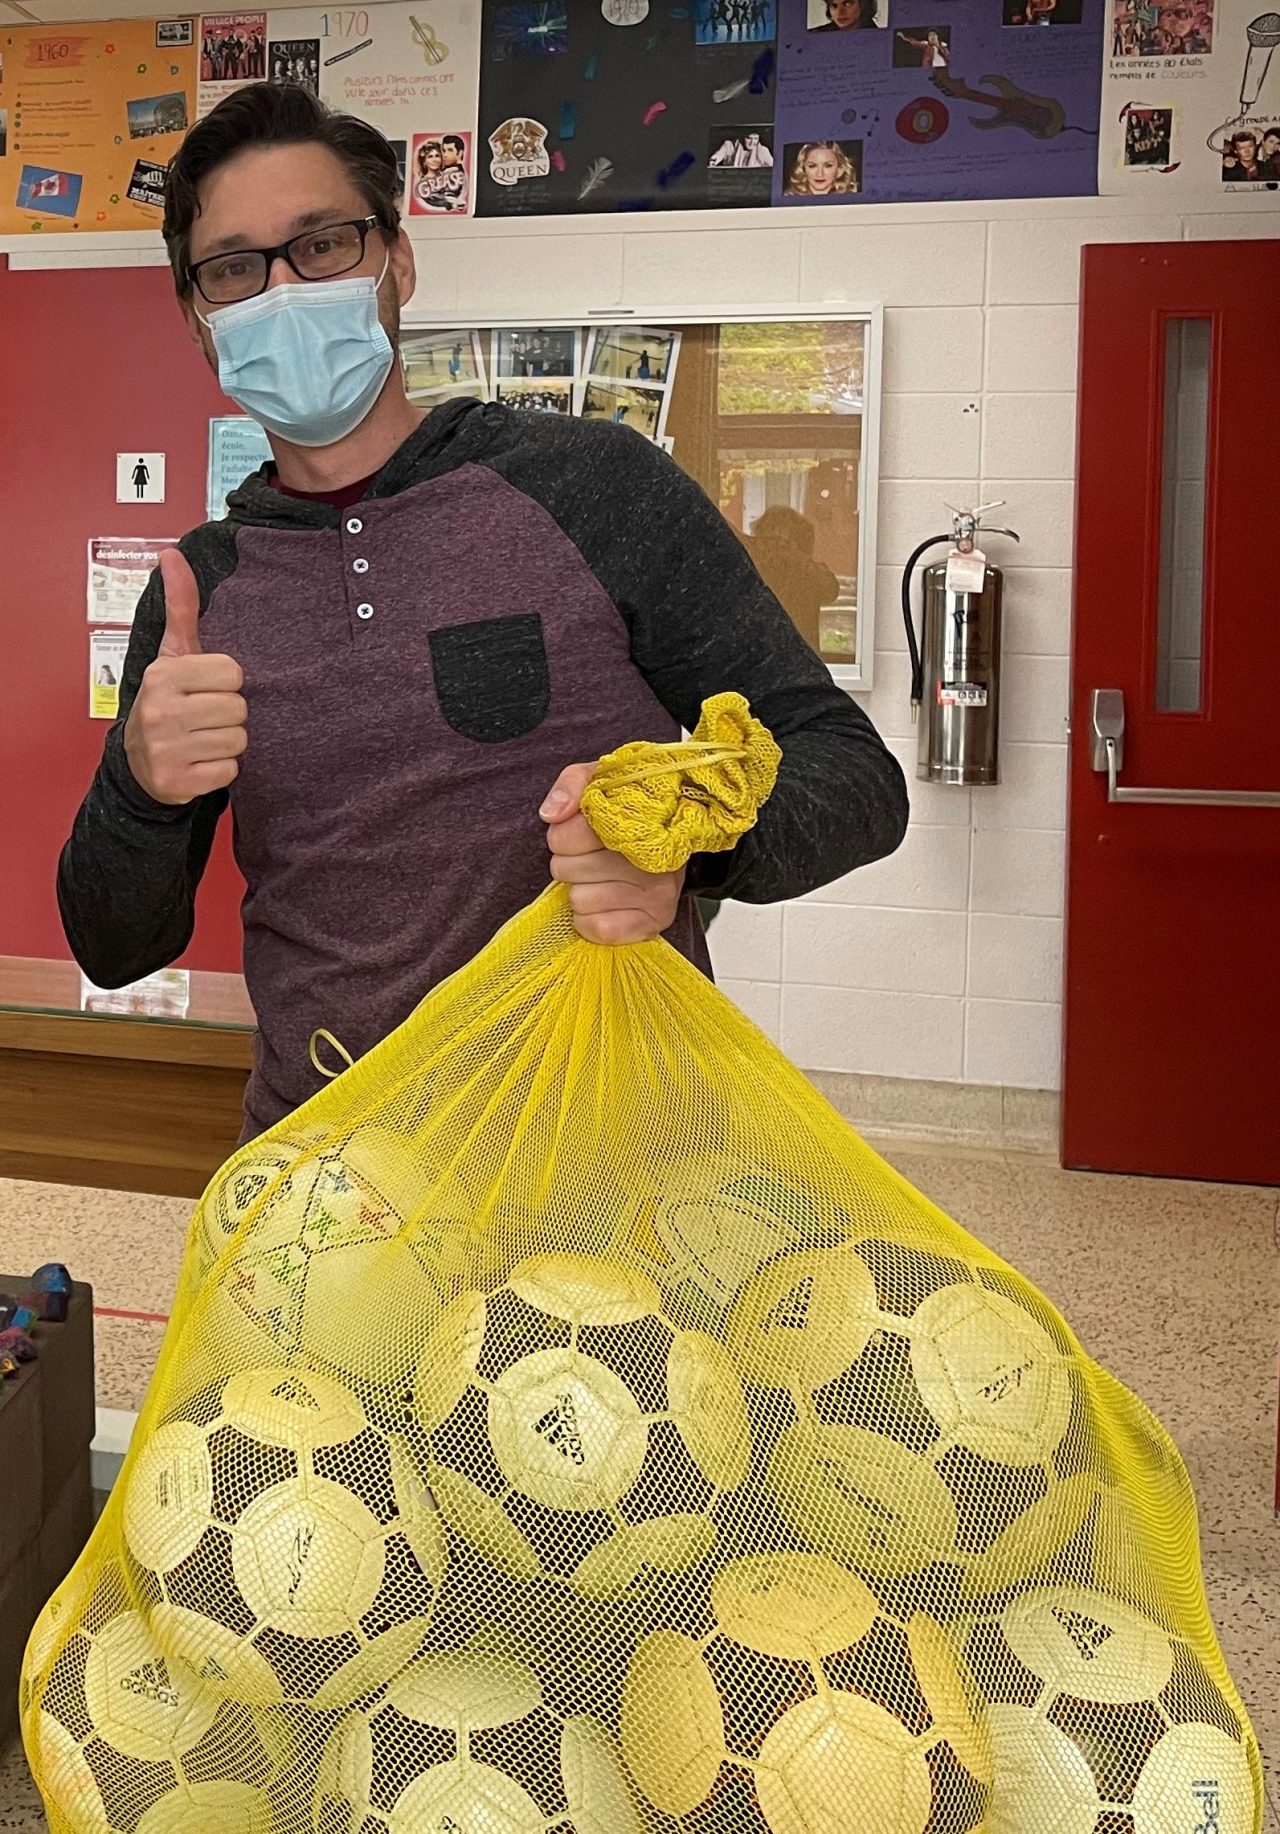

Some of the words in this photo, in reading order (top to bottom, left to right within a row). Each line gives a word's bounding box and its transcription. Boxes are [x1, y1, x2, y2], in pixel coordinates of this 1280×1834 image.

[204, 17, 234, 26] VILLAGE
[236, 15, 264, 25] PEOPLE
[320, 10, 369, 37] 1970
[36, 44, 70, 62] 1960
[272, 42, 316, 59] QUEEN
[492, 164, 547, 183] QUEEN
[418, 171, 465, 198] GREASE
[231, 454, 268, 463] respecte
[96, 549, 142, 560] désinfecter
[1191, 1780, 1220, 1834] Bell
